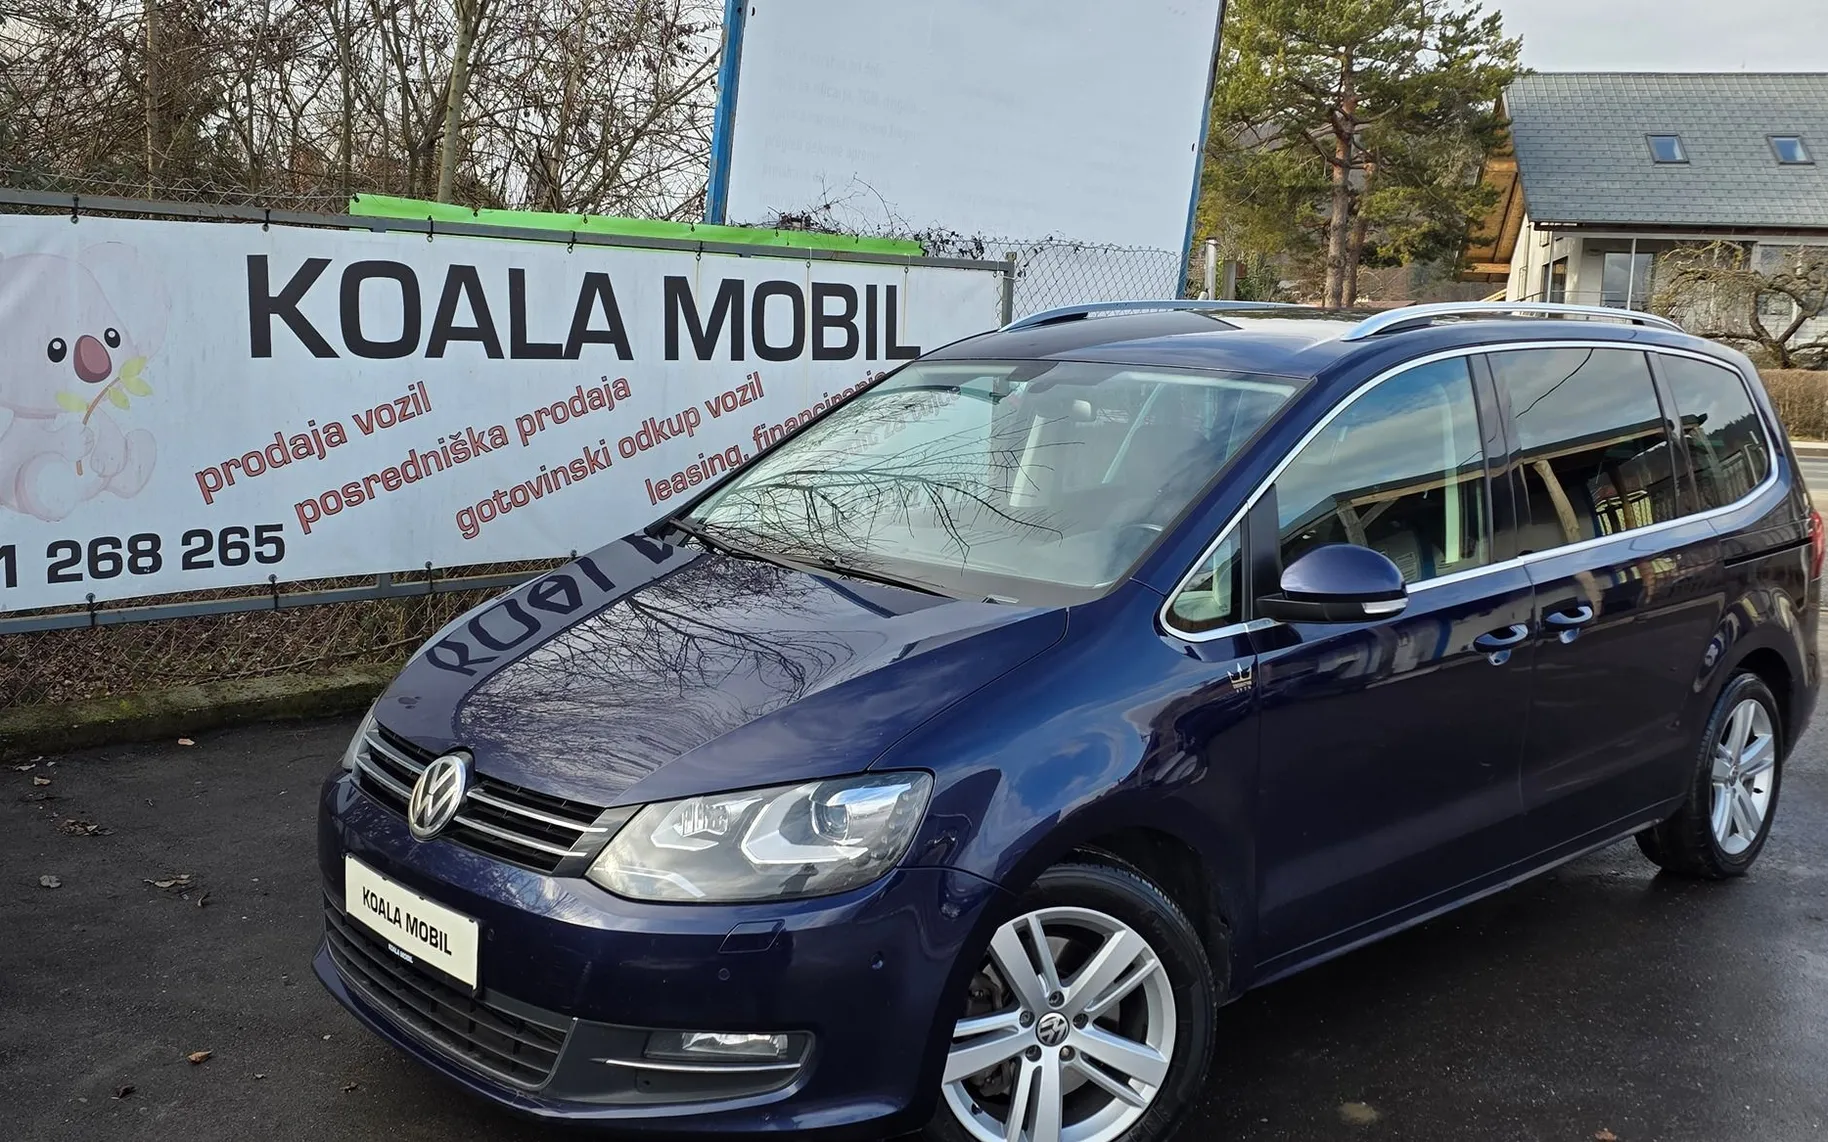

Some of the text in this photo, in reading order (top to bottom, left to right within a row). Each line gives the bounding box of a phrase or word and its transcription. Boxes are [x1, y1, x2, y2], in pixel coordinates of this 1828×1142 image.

[247, 254, 922, 362] KOALA MOBIL
[195, 380, 432, 505] prodaja vozil
[294, 375, 631, 535] posredniška prodaja
[455, 371, 765, 540] gotovinski odkup vozil
[46, 533, 163, 584] 268
[181, 523, 286, 571] 265
[362, 886, 453, 956] KOALA MOBIL
